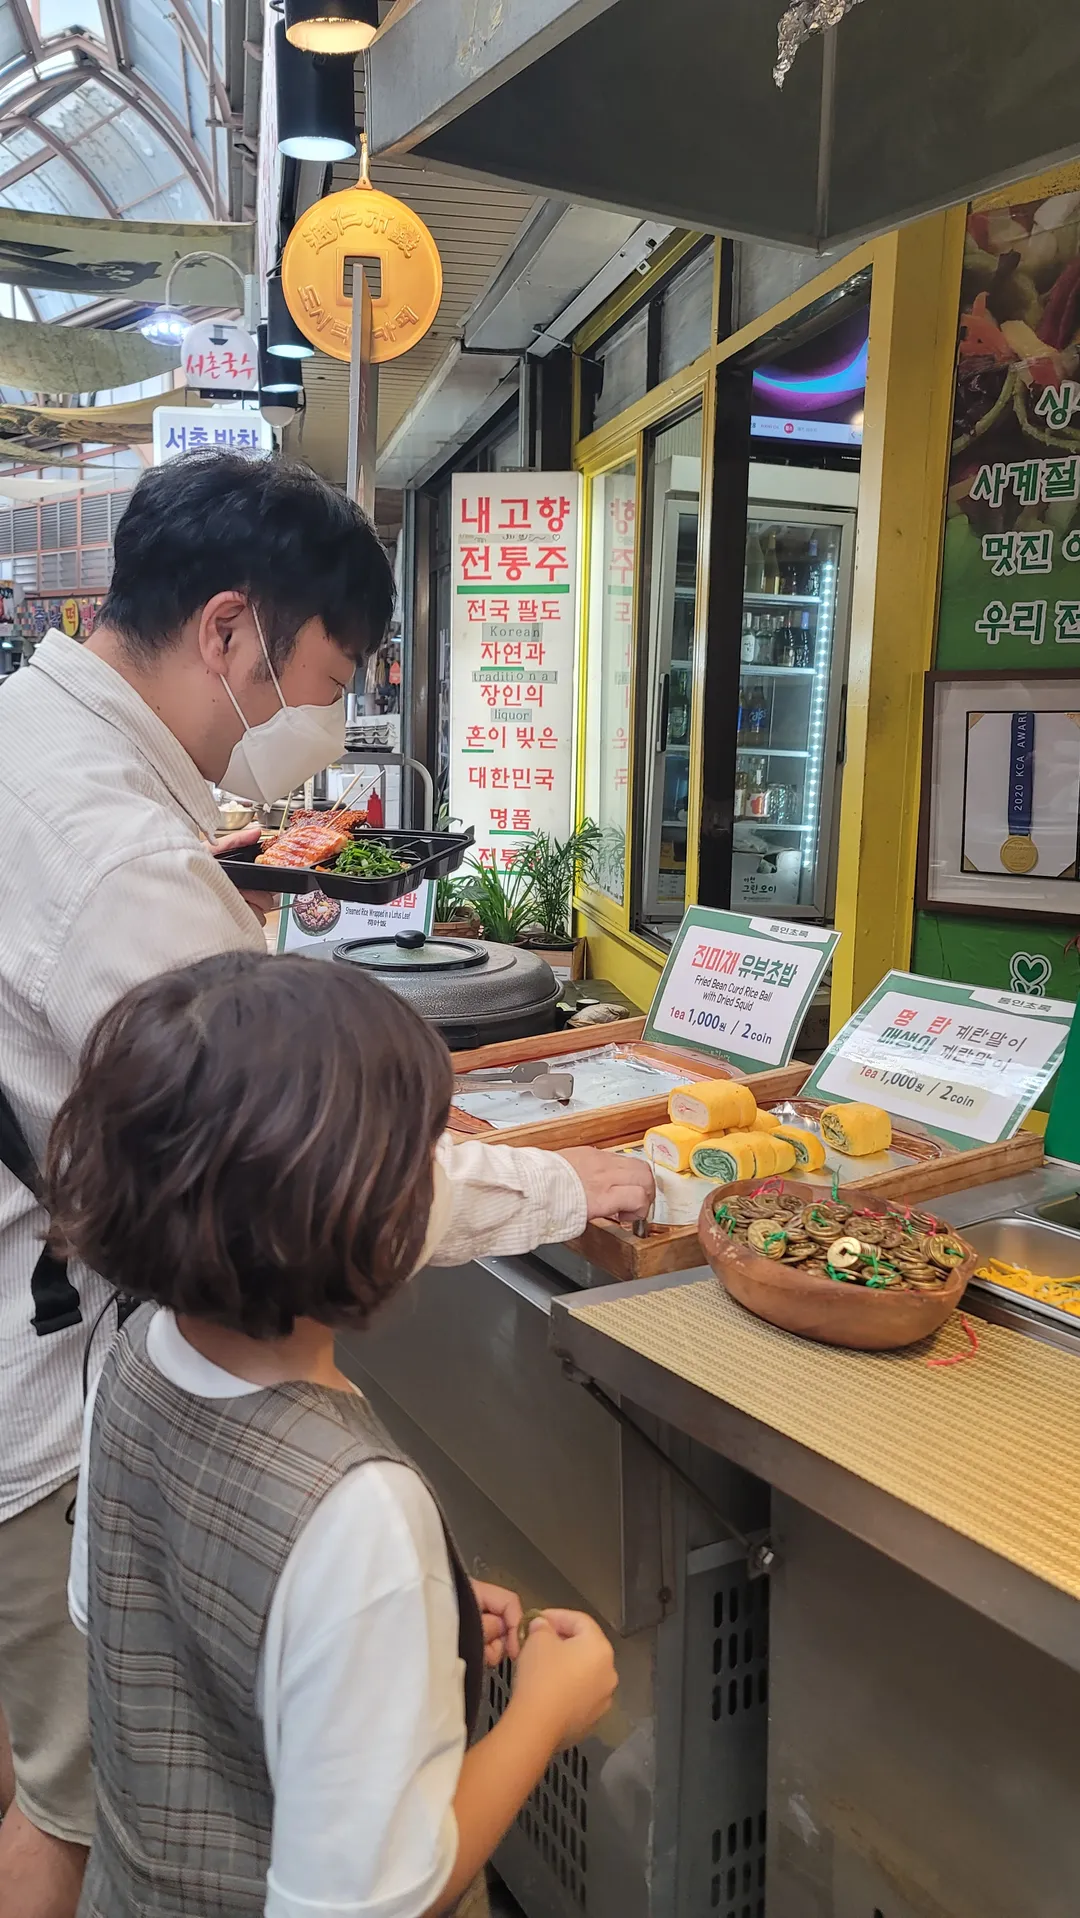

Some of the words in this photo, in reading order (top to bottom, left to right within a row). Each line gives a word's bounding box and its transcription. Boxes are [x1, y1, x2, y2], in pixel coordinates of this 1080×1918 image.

[372, 305, 419, 343] 카페
[186, 351, 256, 380] 서촌국수
[1036, 385, 1080, 428] 싱
[971, 457, 1080, 506] 사계절
[461, 496, 571, 534] 내고향
[460, 545, 569, 582] 전통주
[984, 532, 1051, 576] 멋진
[467, 599, 510, 623] 전국
[518, 599, 561, 622] 팔도
[977, 602, 1046, 643] 우리
[490, 626, 540, 638] Korean
[480, 641, 546, 665] 자연과
[474, 671, 558, 682] traditional
[480, 684, 544, 708] 장인의
[494, 709, 529, 722] liquor
[466, 725, 507, 749] 혼이
[516, 726, 559, 749] 빚은
[468, 767, 555, 791] 대한민국
[1015, 755, 1025, 777] KCA
[1013, 784, 1024, 811] 2020
[489, 808, 532, 830] 명품
[345, 907, 361, 916] Steamed
[361, 908, 369, 916] Rice
[691, 944, 741, 975] 진미채
[738, 954, 799, 988] 유부초밥
[694, 974, 713, 989] Fried
[711, 979, 728, 992] Bean
[728, 983, 745, 995] Curd
[744, 987, 759, 999] Rice
[759, 990, 774, 1003] Ball
[702, 991, 717, 1001] with
[716, 993, 735, 1007] Dried
[734, 998, 754, 1012] Squid
[669, 1006, 686, 1021] 1ea
[688, 1009, 727, 1032] 1,000원
[730, 1020, 740, 1036] /
[876, 1026, 938, 1055] 매생이
[955, 1024, 1028, 1052] 계란말이
[859, 1065, 878, 1080] 1ea
[926, 1081, 941, 1097] /
